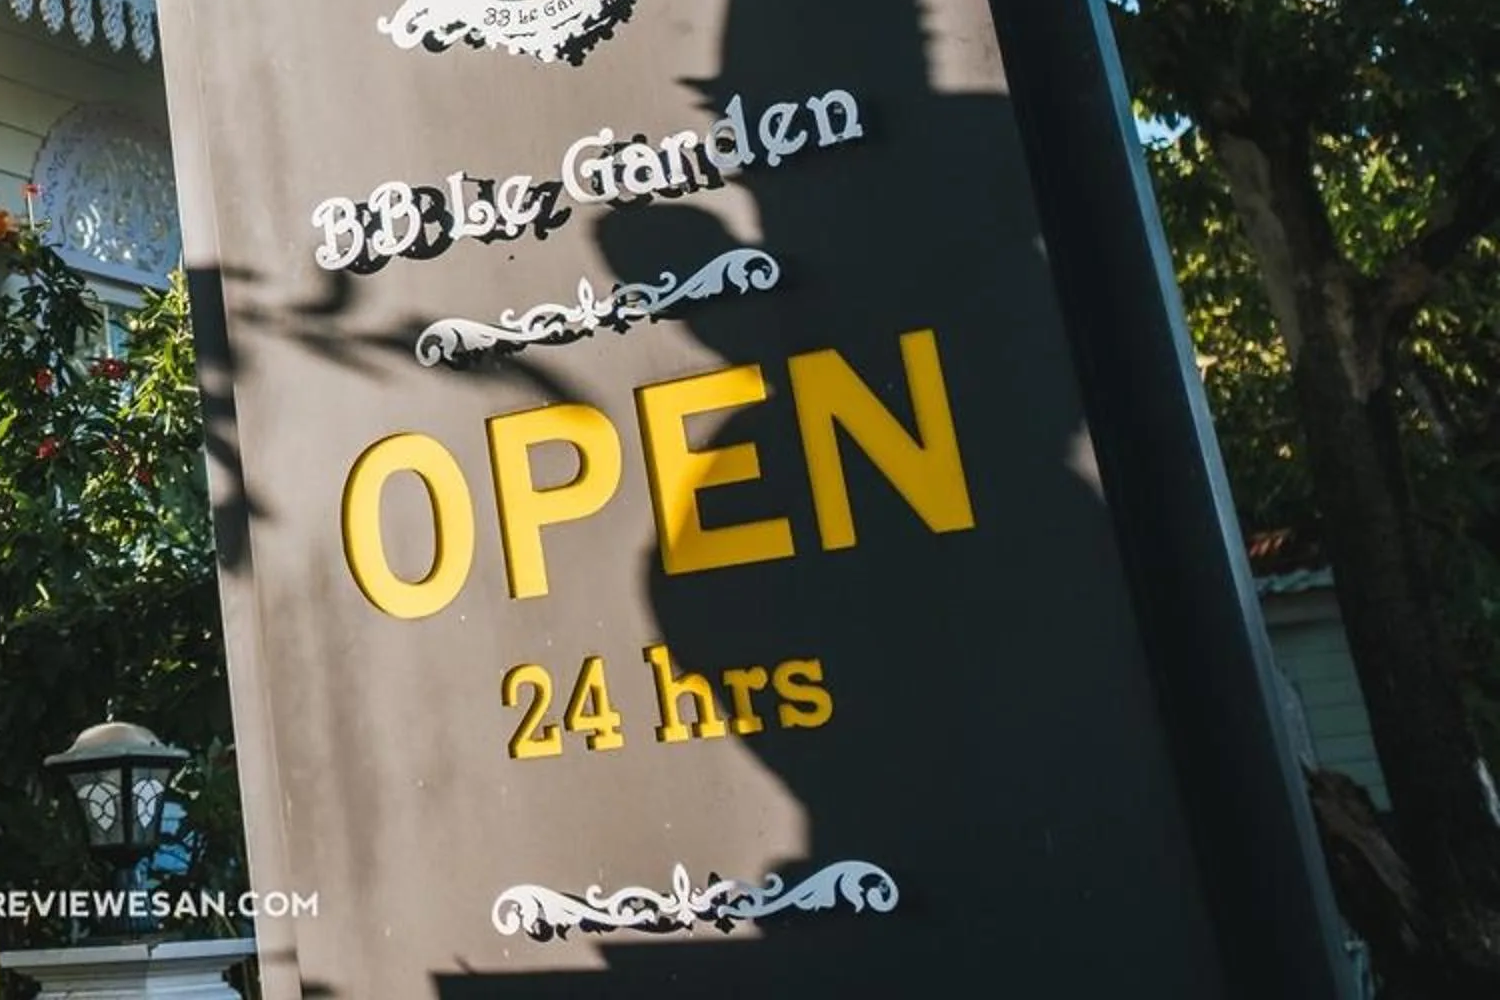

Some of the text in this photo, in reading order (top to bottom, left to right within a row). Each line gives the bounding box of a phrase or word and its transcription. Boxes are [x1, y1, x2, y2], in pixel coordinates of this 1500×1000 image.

[312, 89, 863, 271] BB Le Garden
[341, 329, 975, 620] OPEN
[502, 644, 834, 759] 24 hrs
